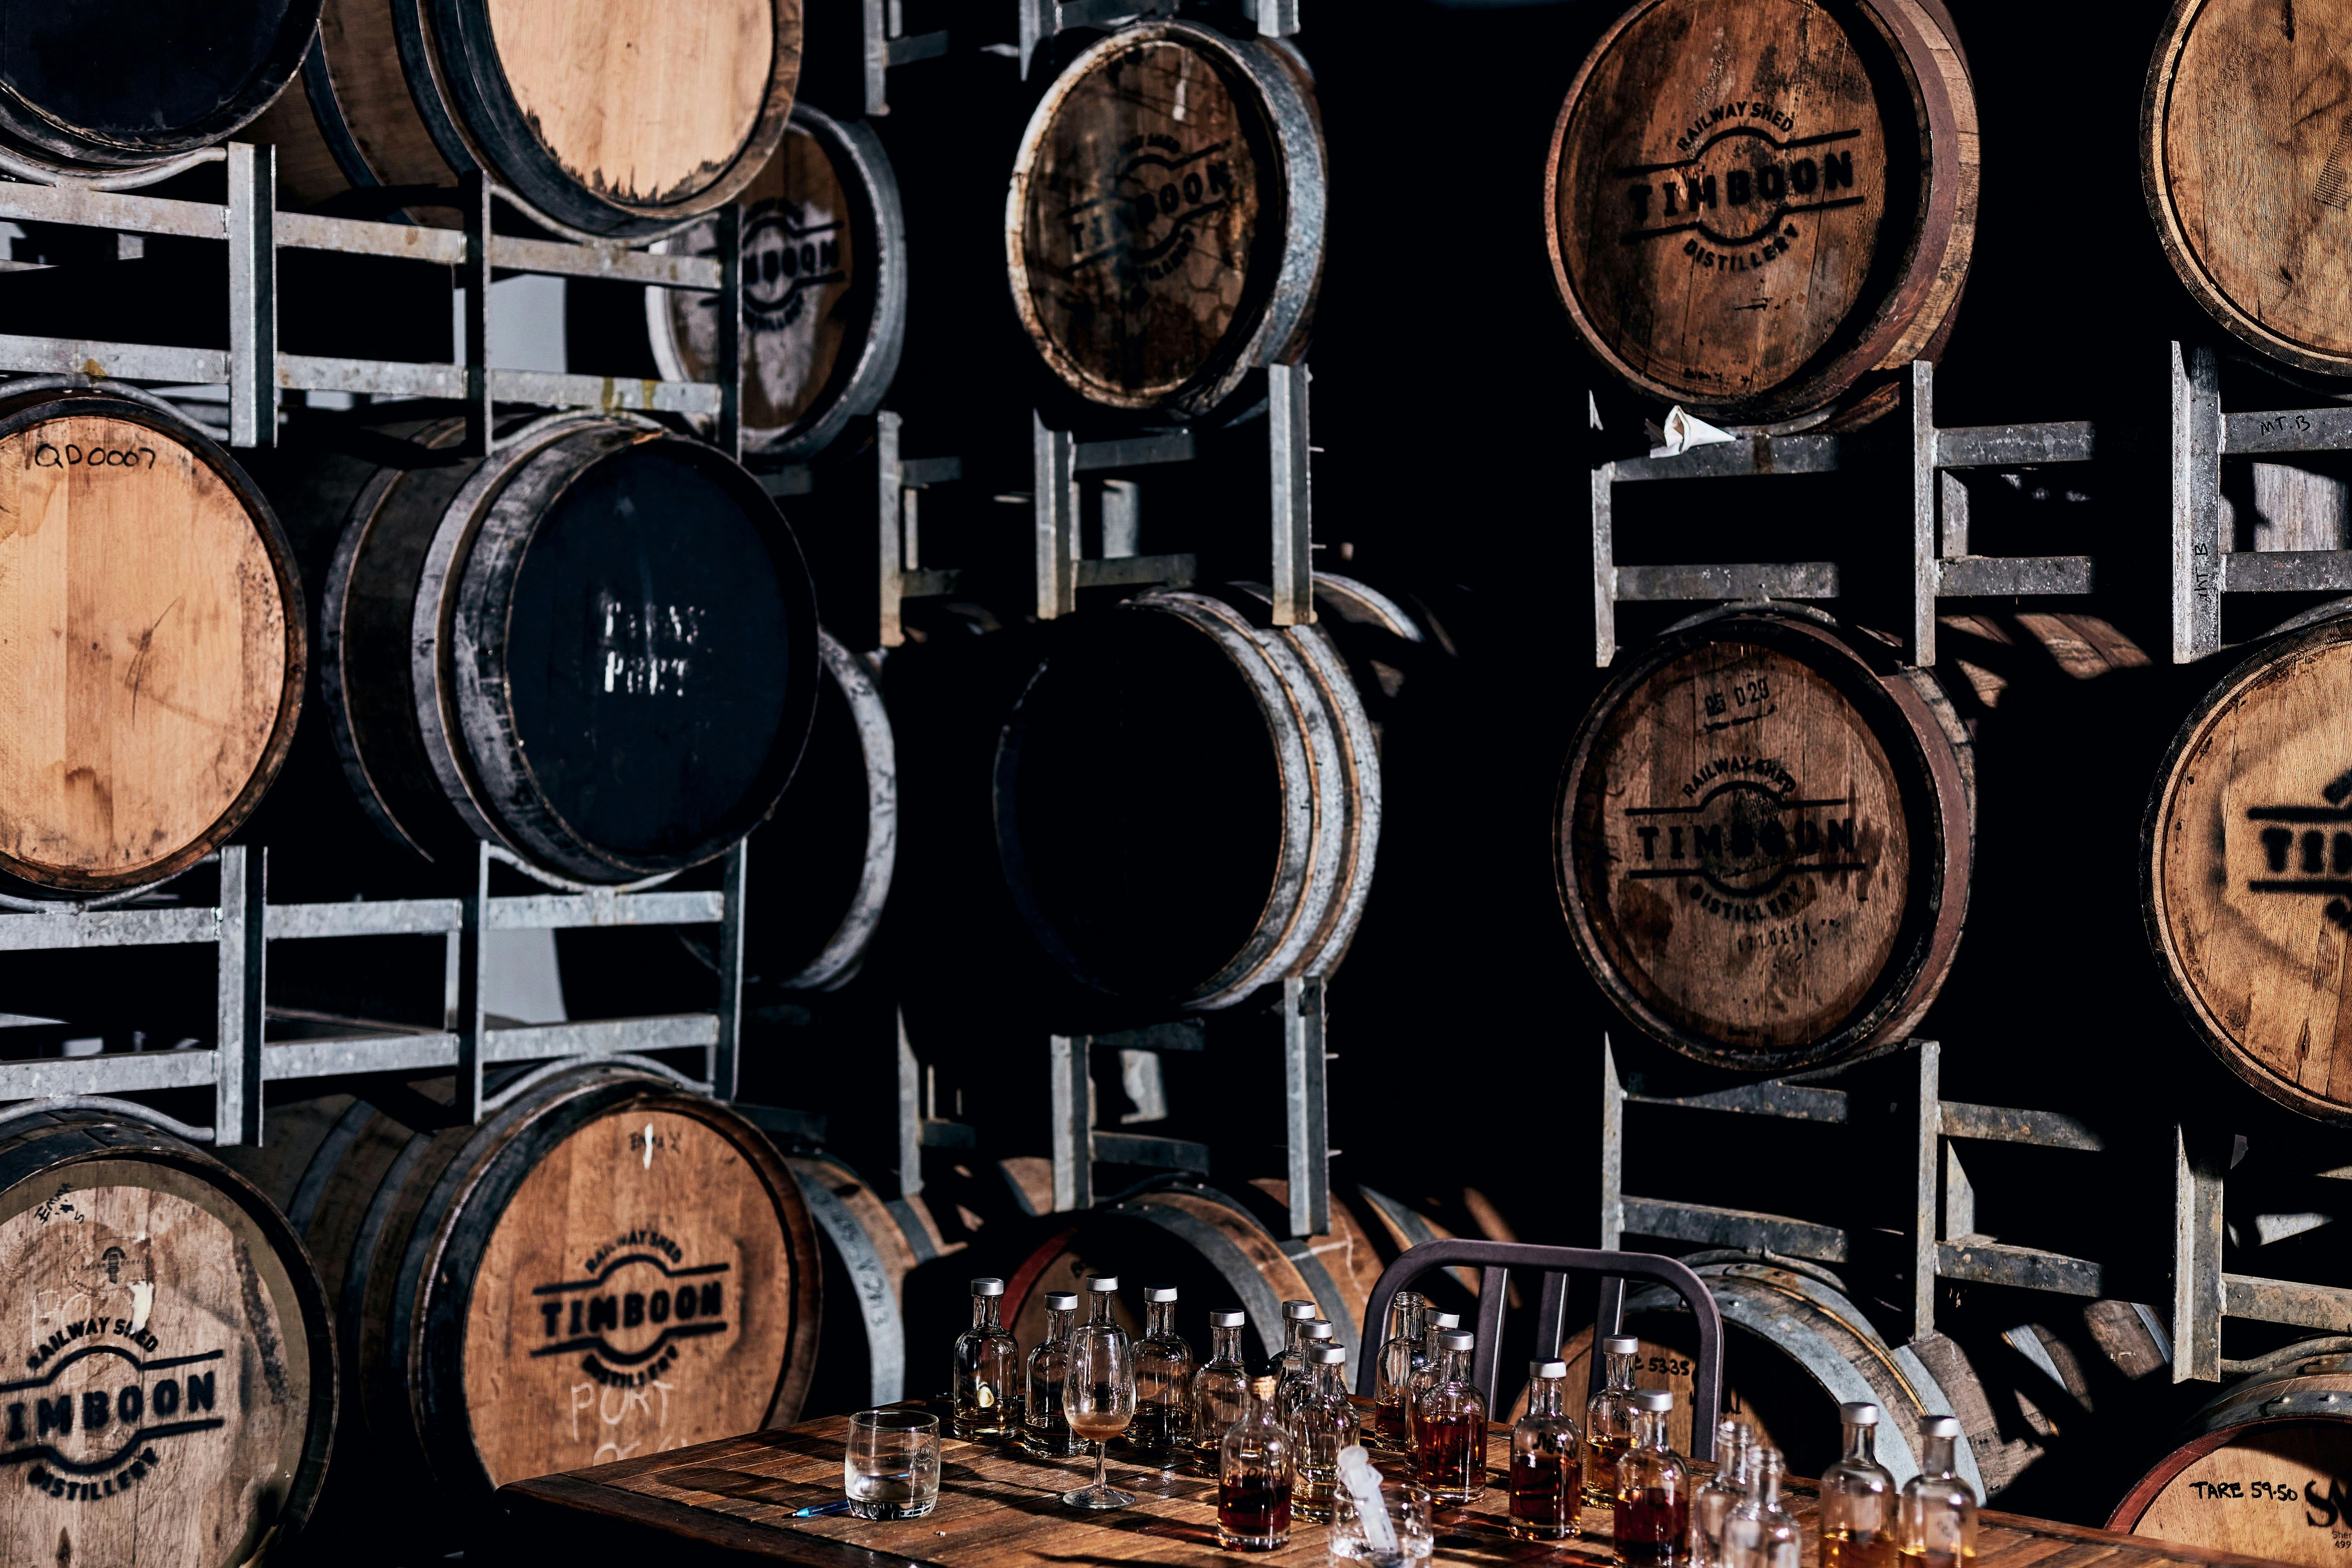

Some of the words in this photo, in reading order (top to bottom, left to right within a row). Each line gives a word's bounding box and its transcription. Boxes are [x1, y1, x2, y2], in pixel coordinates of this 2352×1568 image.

[1677, 101, 1748, 152] RAILWAY
[1751, 102, 1794, 132] SHED
[1628, 151, 1853, 225] TIMBOON
[1684, 223, 1798, 272] DISTILLERY
[1682, 756, 1751, 798] RAILWAY
[1637, 818, 1855, 861] TIMBOON
[1690, 880, 1800, 922] DISTILLERY
[541, 1281, 721, 1338] TIMBOON
[8, 1372, 215, 1443] IMBOON
[571, 1380, 675, 1442] PORT
[2189, 1481, 2244, 1499] TARE
